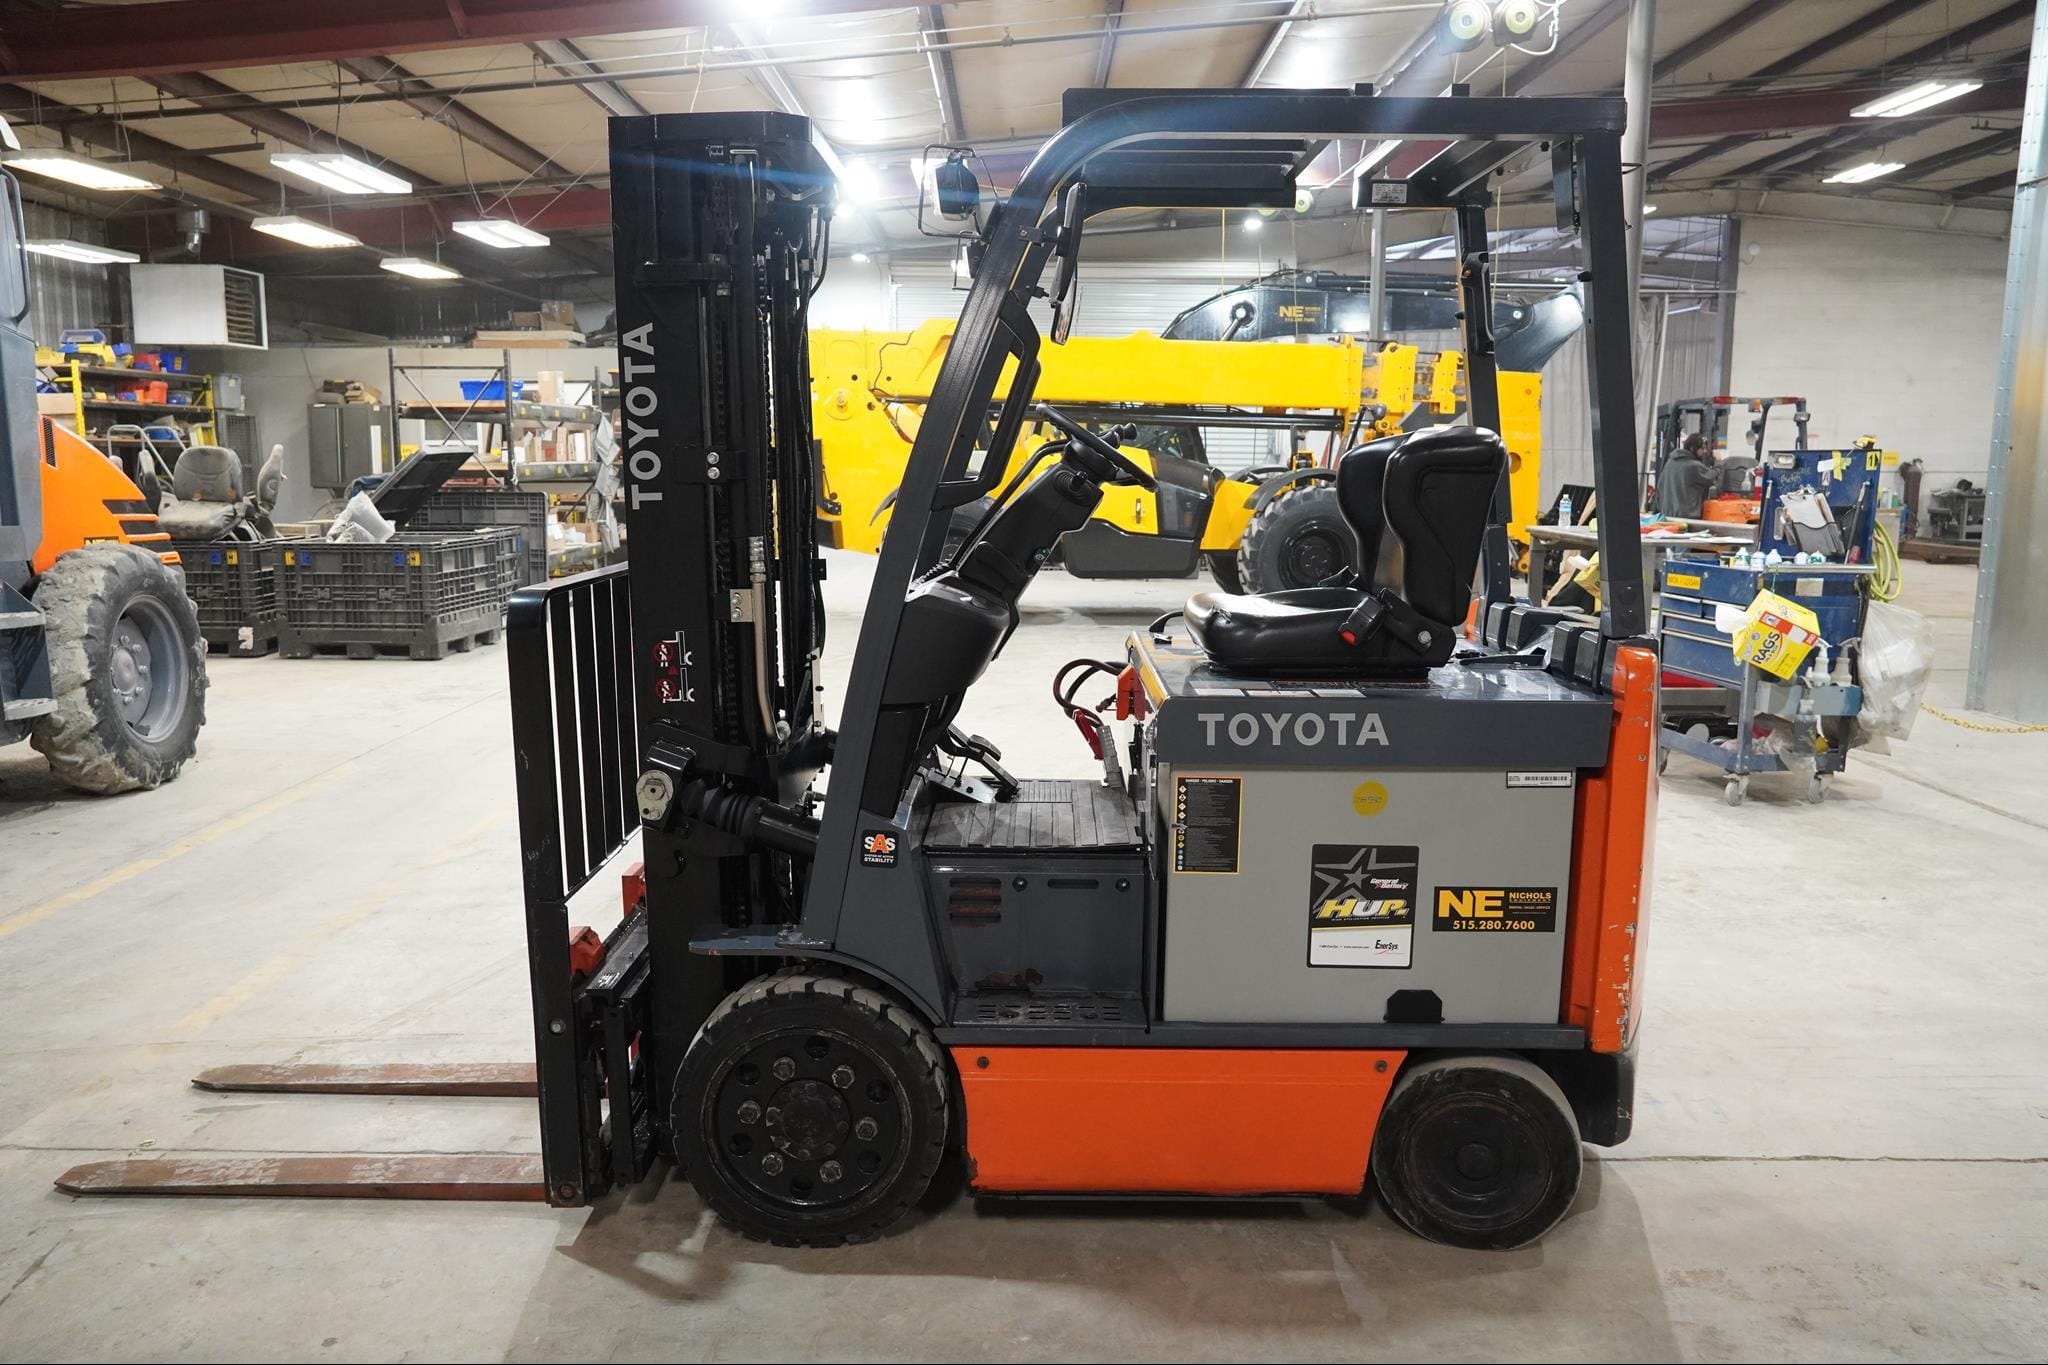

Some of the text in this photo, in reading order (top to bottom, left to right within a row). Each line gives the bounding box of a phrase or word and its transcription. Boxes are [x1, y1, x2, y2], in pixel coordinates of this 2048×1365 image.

[1279, 305, 1304, 317] NE
[622, 322, 663, 510] TOYOTA
[1752, 632, 1780, 664] RAGS
[1198, 712, 1390, 746] TOYOTA
[864, 834, 896, 853] SAS
[1438, 890, 1504, 918] NE
[1453, 920, 1535, 930] 515.280.7600
[1375, 940, 1398, 951] EnerSys
